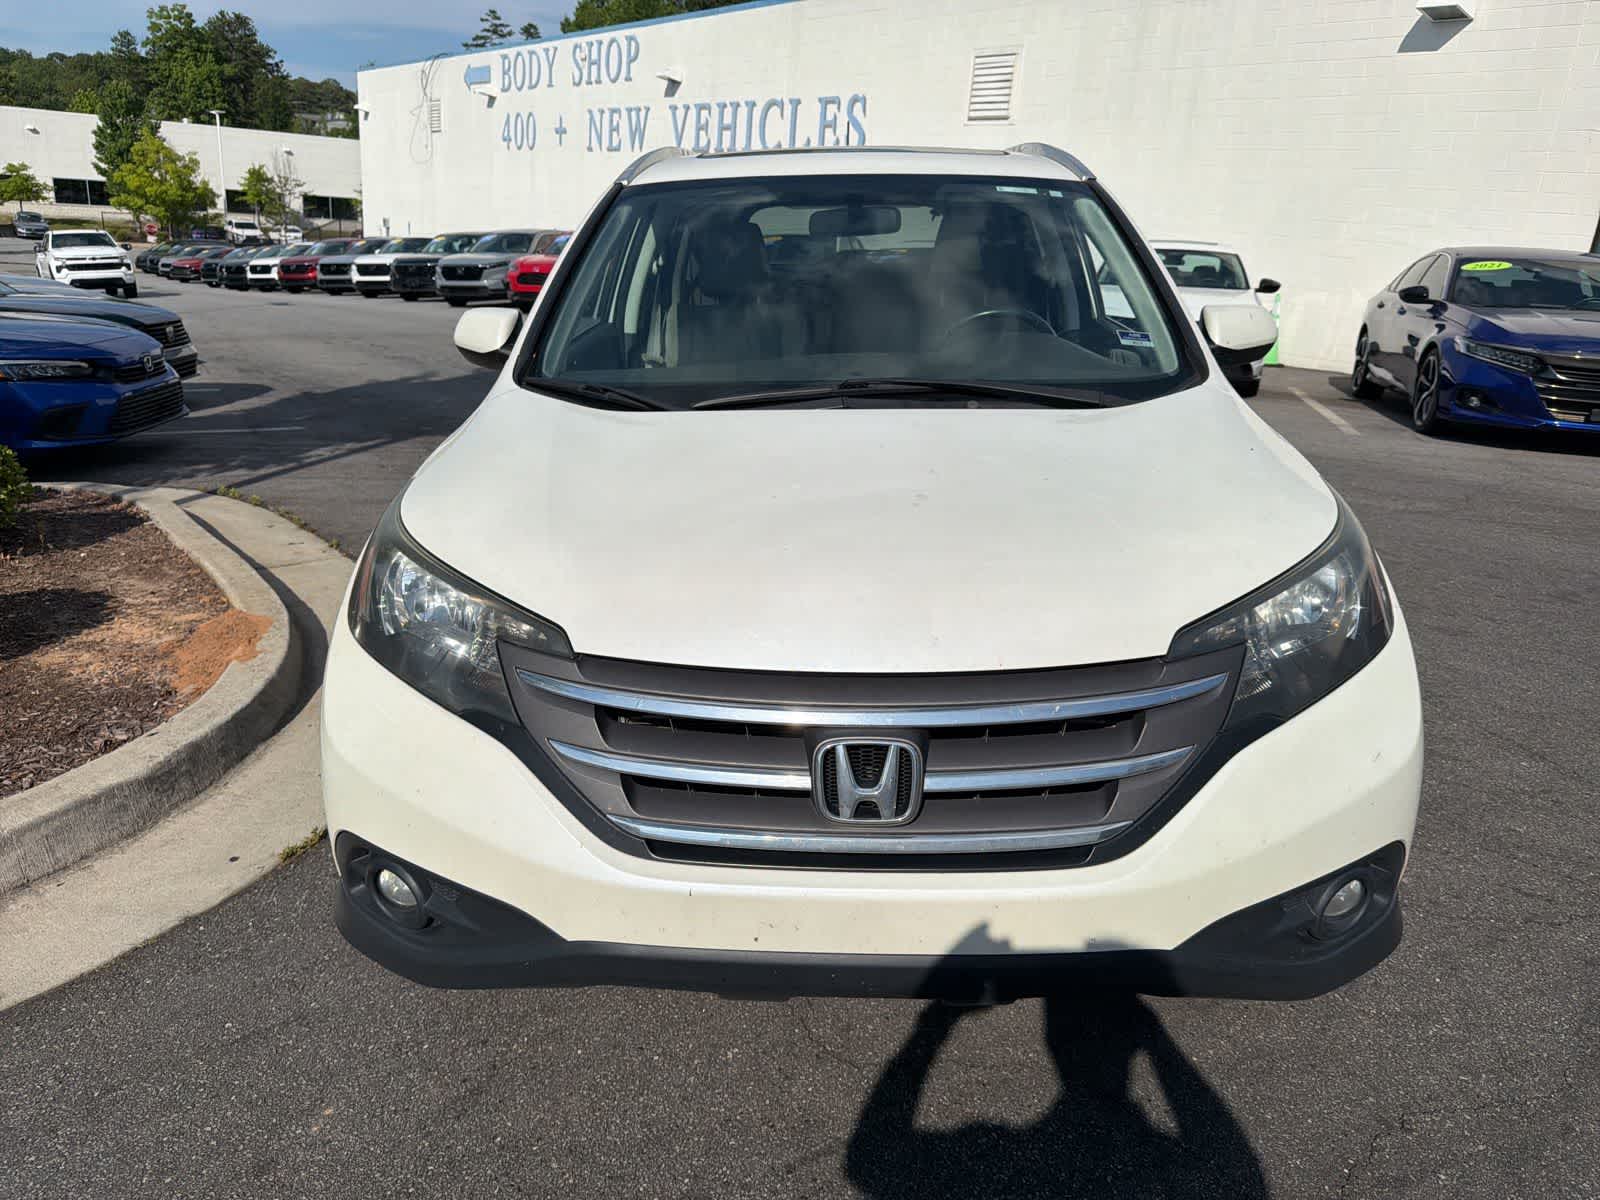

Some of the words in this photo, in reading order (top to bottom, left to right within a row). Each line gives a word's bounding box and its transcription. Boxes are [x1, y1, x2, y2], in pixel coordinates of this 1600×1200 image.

[500, 47, 558, 93] BODY
[572, 35, 640, 87] SHOP
[502, 112, 537, 151] 400
[554, 113, 568, 147] +
[586, 105, 651, 152] NEW
[668, 93, 867, 152] VEHICLES
